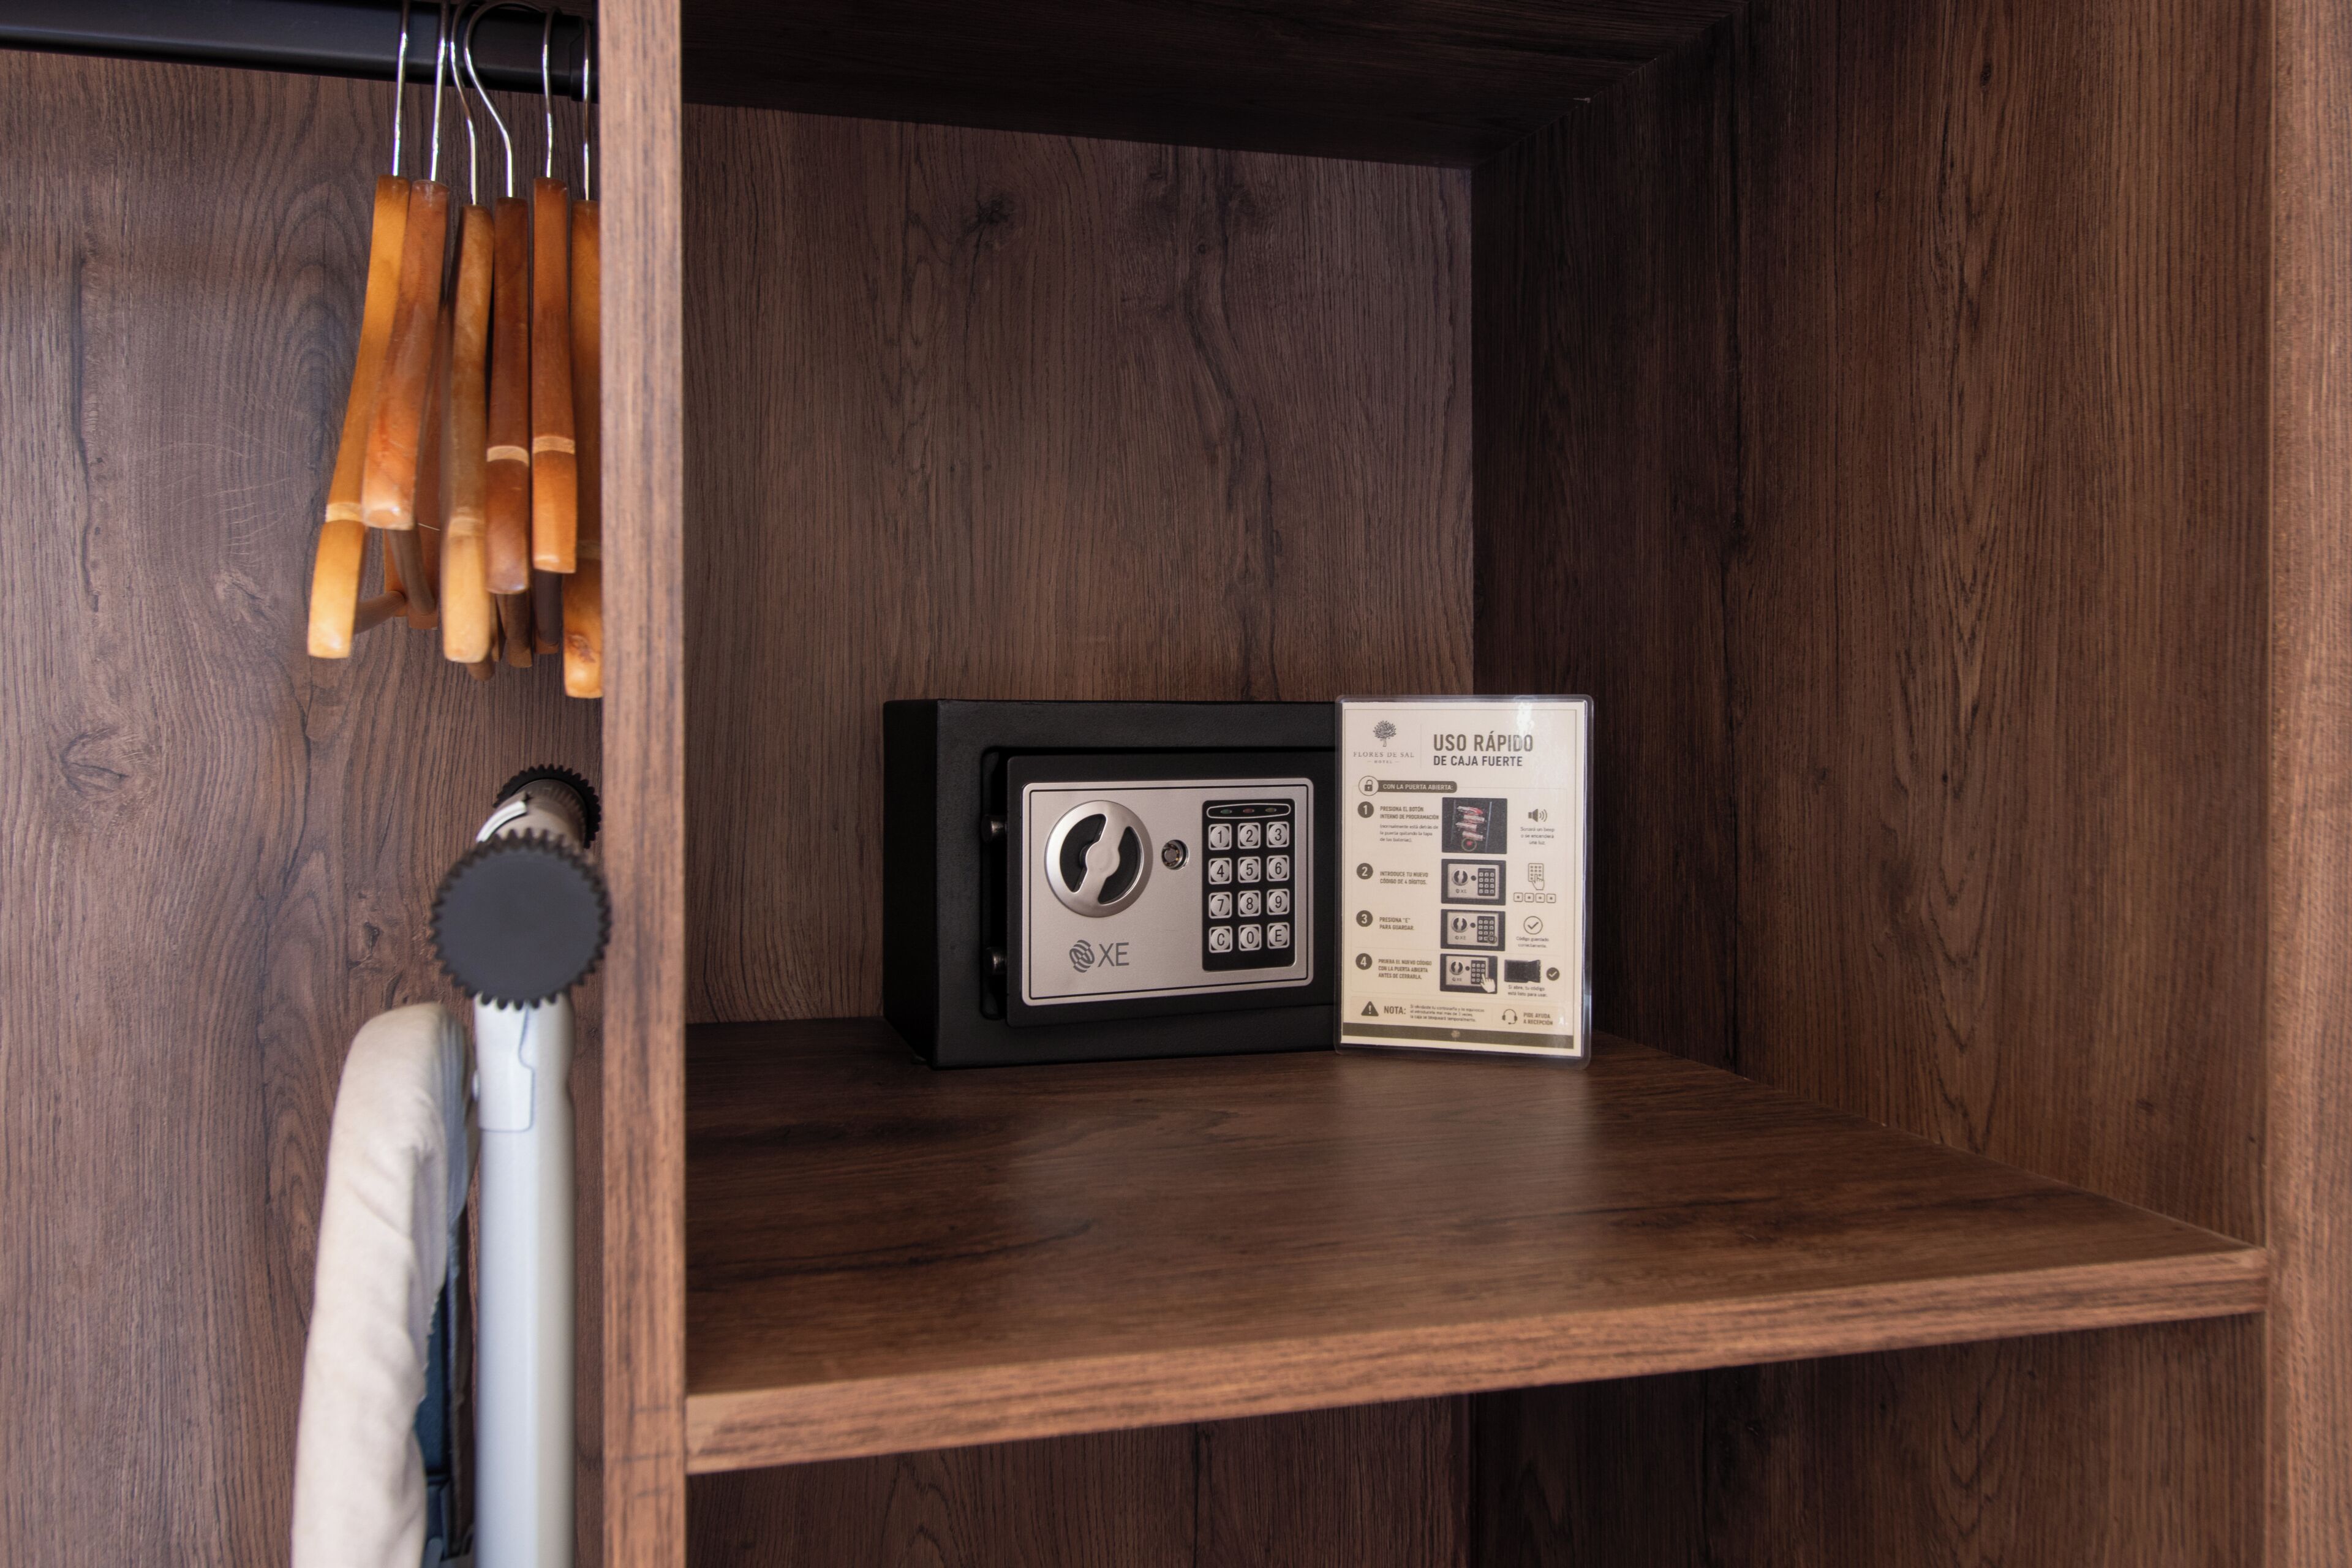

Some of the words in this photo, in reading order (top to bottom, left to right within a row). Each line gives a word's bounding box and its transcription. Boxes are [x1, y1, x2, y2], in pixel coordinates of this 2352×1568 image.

[1433, 734, 1466, 752] USO
[1474, 730, 1533, 752] RÁPIDO
[1433, 755, 1447, 766] DE
[1451, 755, 1478, 766] CAJA
[1482, 756, 1523, 766] FUERTE
[1363, 805, 1368, 815] 1
[1217, 830, 1222, 843] 1
[1246, 829, 1253, 843] 2
[1275, 828, 1282, 841] 3
[1216, 864, 1224, 878] 4
[1246, 863, 1253, 876] 5
[1275, 862, 1282, 875] 6
[1362, 867, 1368, 876] 2
[1217, 899, 1224, 912] 7
[1246, 897, 1254, 910] 8
[1275, 895, 1282, 908] 9
[1361, 914, 1368, 924] 3
[1217, 933, 1225, 946] C
[1246, 931, 1254, 944] 0
[1275, 929, 1282, 942] E
[1098, 942, 1129, 968] XE
[1360, 957, 1367, 967] 4
[1384, 1006, 1406, 1015] NOTA:
